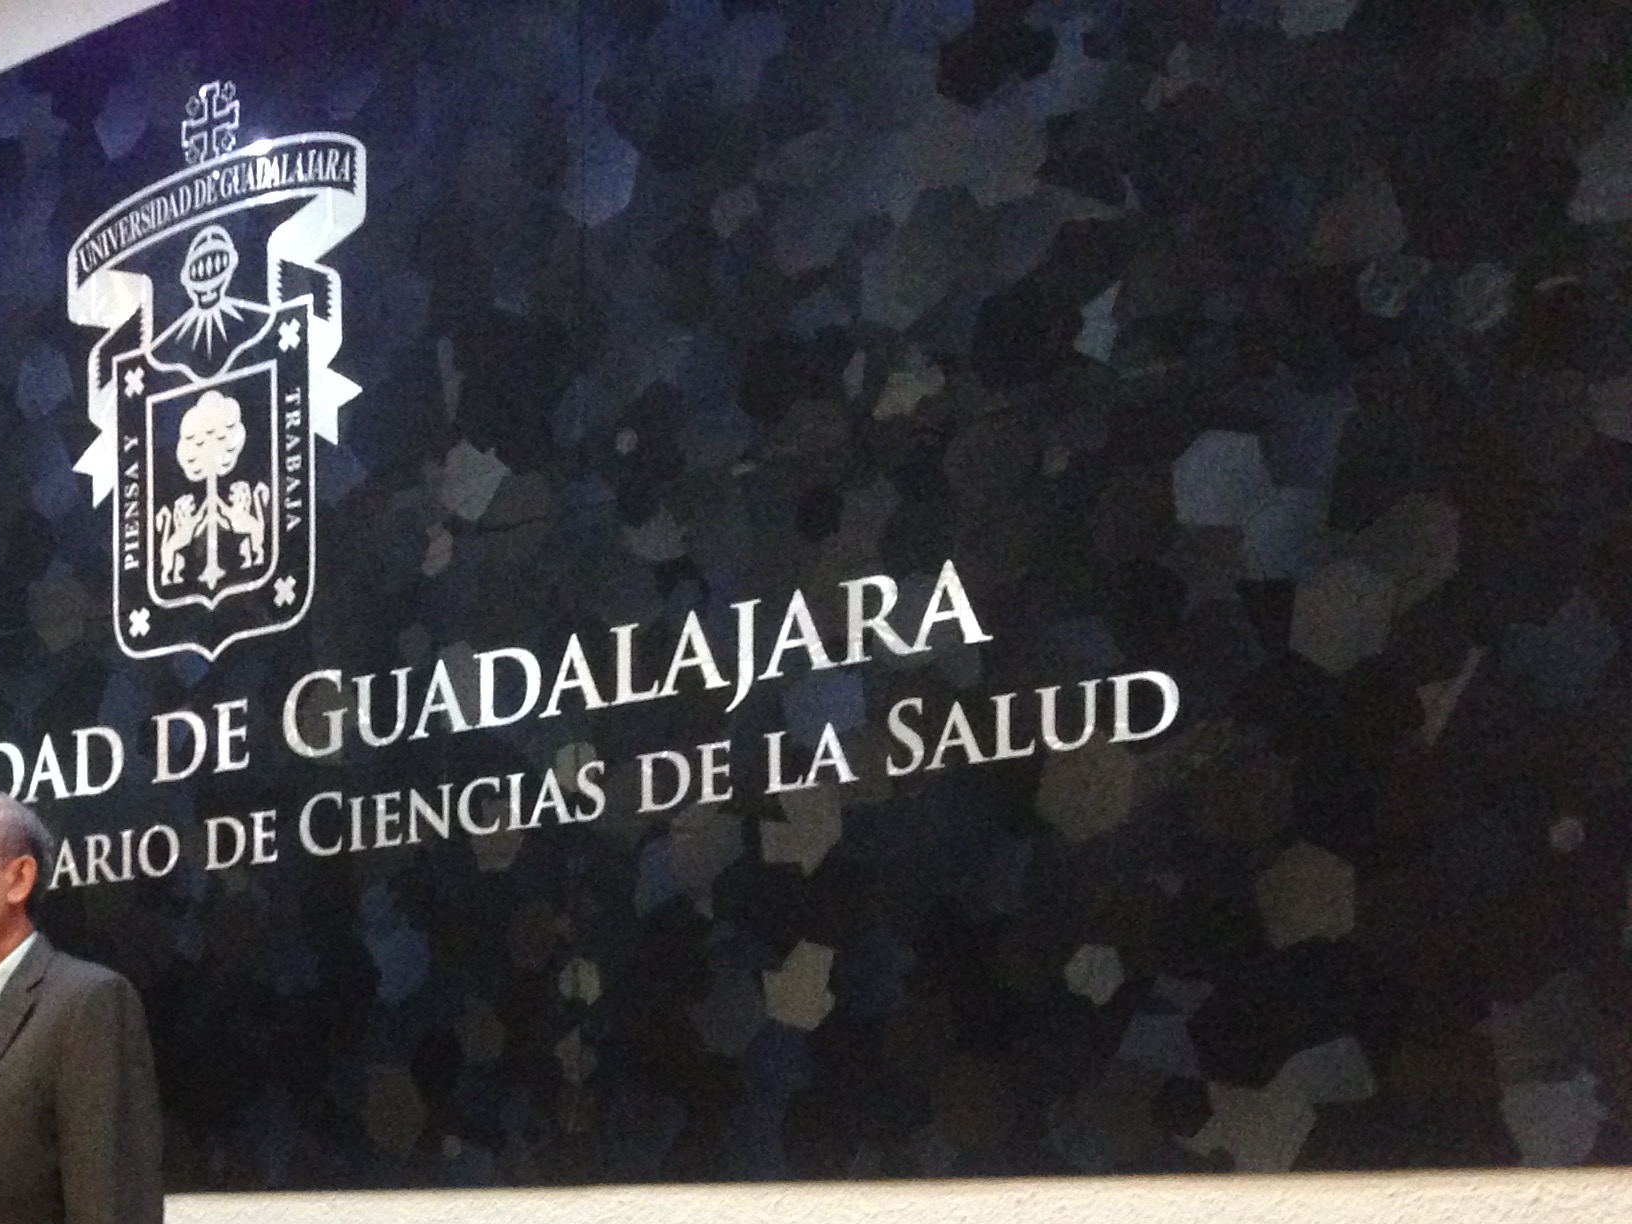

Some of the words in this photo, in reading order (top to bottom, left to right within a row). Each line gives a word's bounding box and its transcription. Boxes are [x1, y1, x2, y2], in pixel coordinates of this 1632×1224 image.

[77, 184, 191, 273] UNIVERSIDAD
[194, 169, 219, 206] DE
[219, 148, 351, 198] GUADALAJARA
[123, 434, 140, 453] Y
[284, 386, 303, 533] TRABAJA
[123, 461, 141, 571] PIENSA
[151, 699, 251, 785] DE
[282, 558, 993, 759] GUADALAJARA
[204, 809, 279, 872] DE
[299, 760, 606, 857] CIENCIAS
[636, 740, 734, 813] DE
[764, 722, 860, 795] LA
[885, 669, 1181, 777] SALUD
